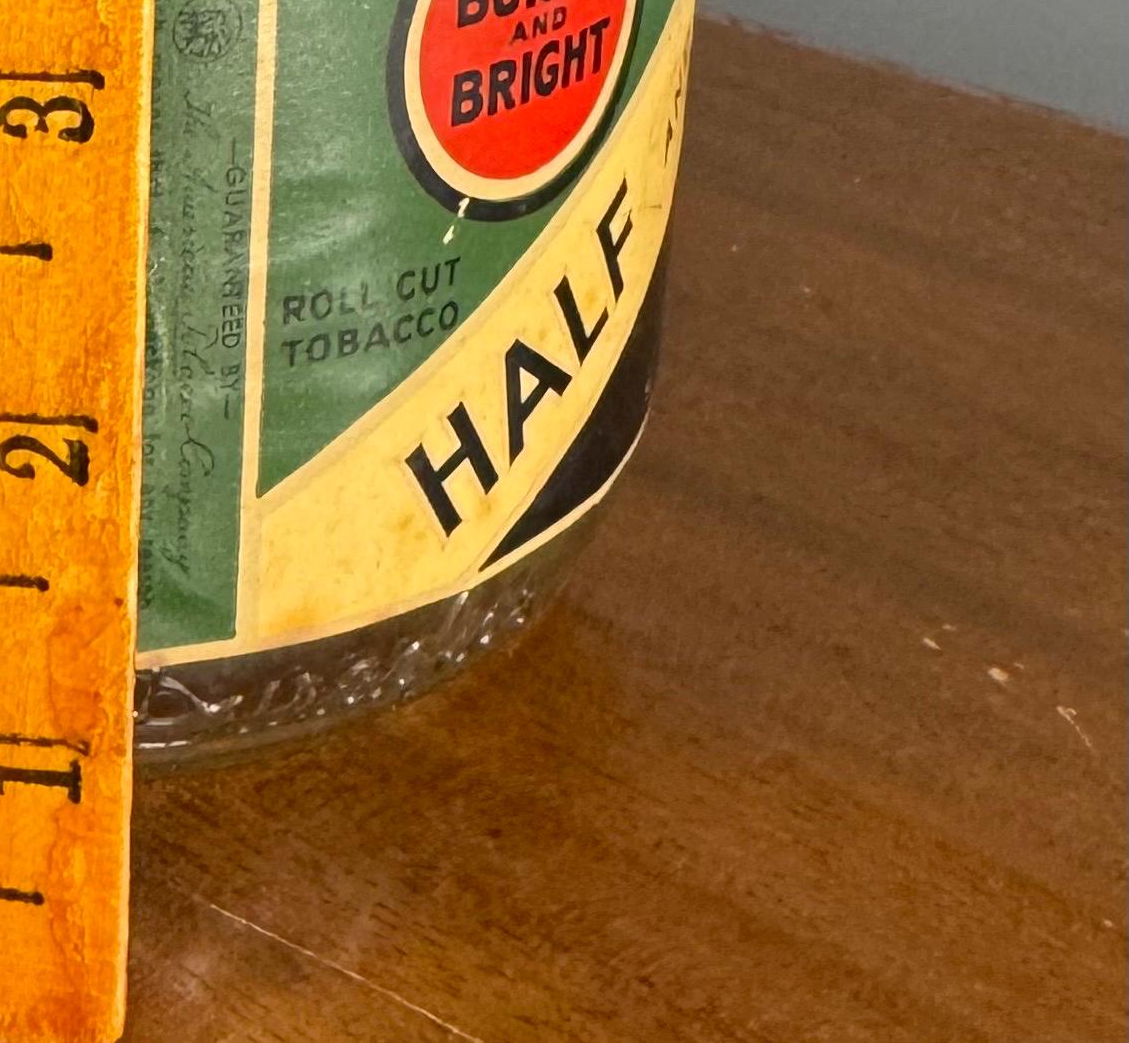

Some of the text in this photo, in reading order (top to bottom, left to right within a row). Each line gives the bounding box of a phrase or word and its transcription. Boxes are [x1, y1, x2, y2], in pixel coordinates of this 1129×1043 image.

[509, 6, 568, 45] AND
[450, 17, 612, 128] BRIGHT
[282, 256, 462, 325] ROLL CUT
[282, 300, 460, 368] TOBACCO
[404, 177, 634, 537] HALF
